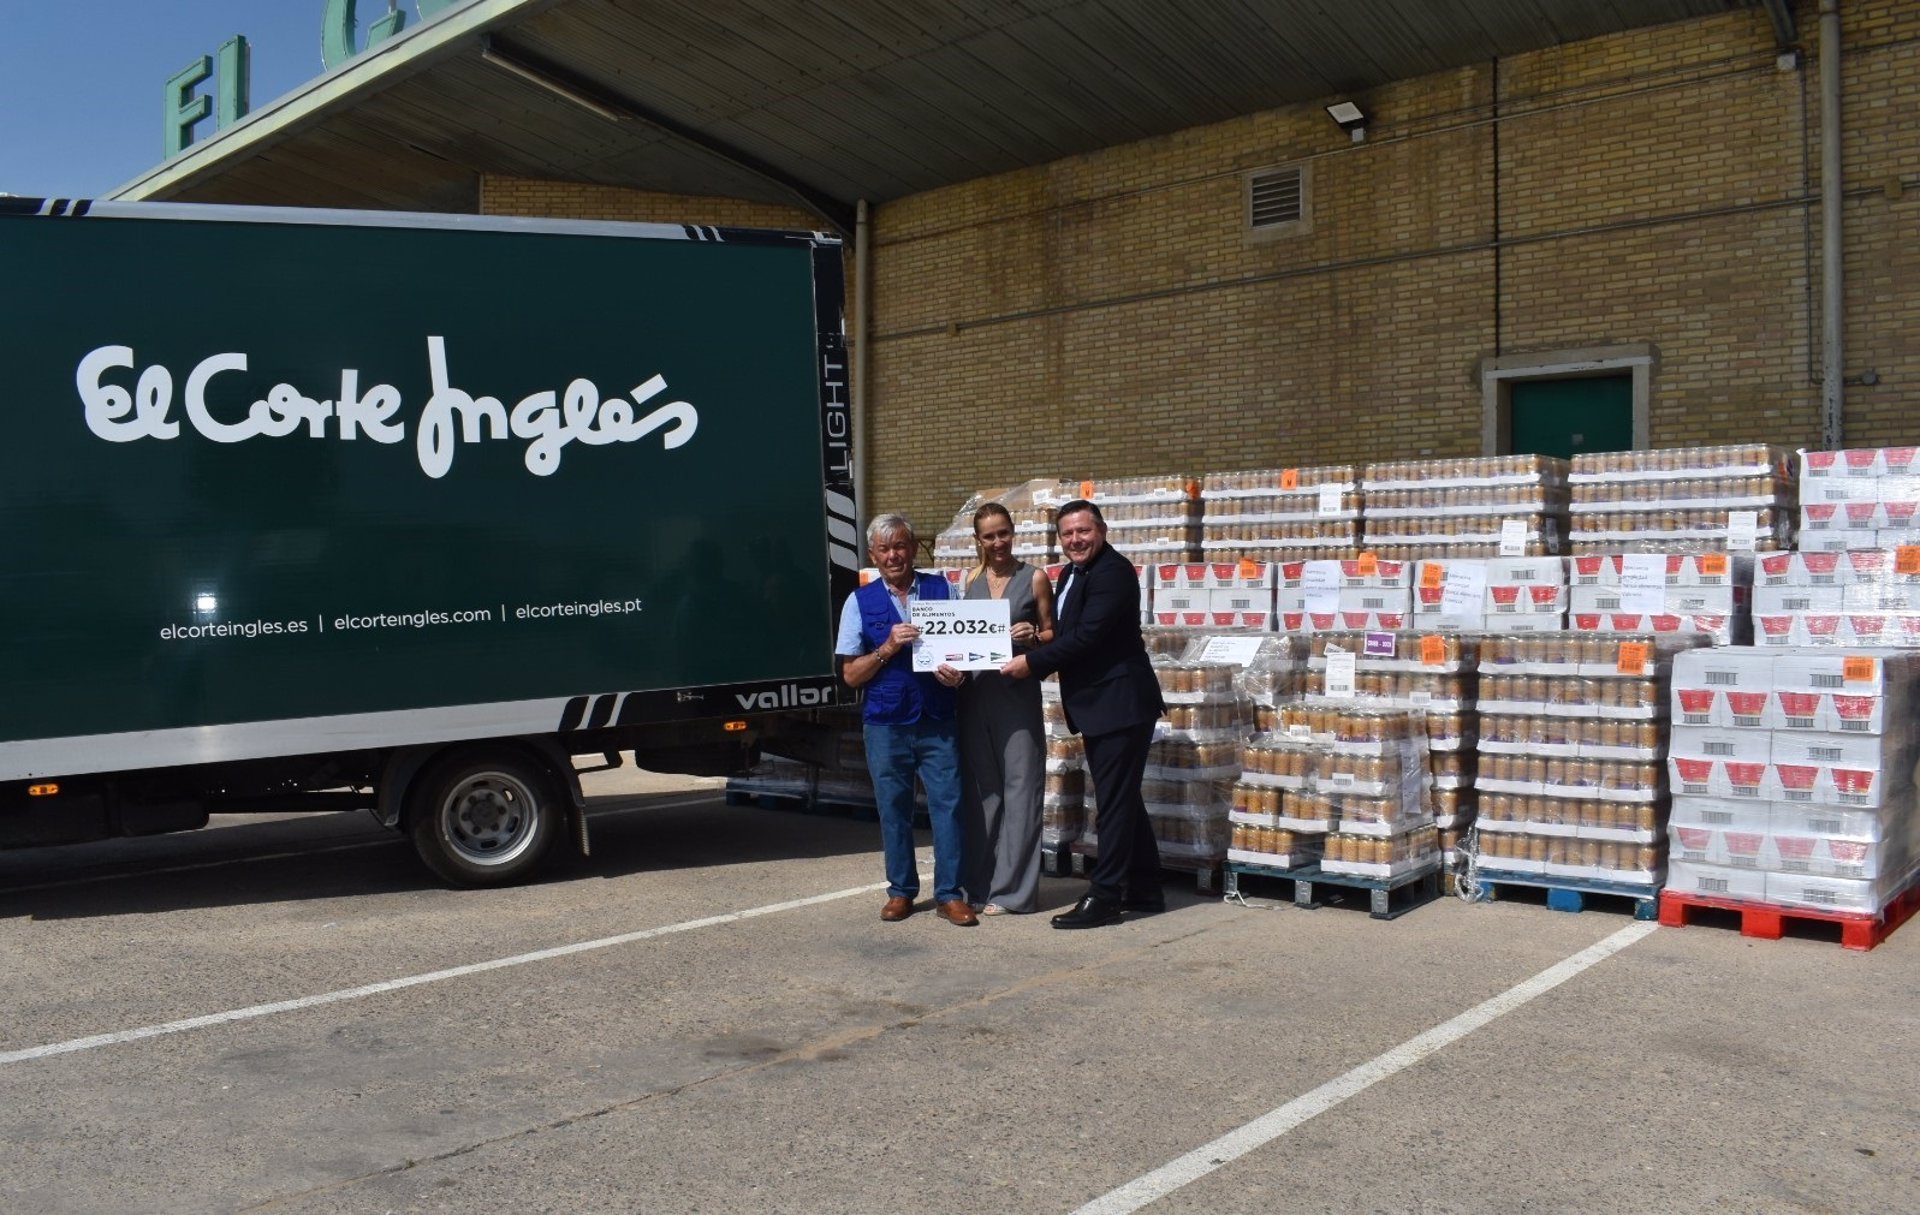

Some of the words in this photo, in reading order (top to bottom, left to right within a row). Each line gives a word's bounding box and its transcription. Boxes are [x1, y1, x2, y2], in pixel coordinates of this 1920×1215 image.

[77, 345, 180, 443] El
[185, 352, 405, 444] Corte
[416, 336, 698, 478] Inglés
[824, 354, 848, 471] LIGHT
[160, 616, 308, 640] elcorteingles.es
[334, 608, 492, 630] elcorteingles.com
[515, 597, 642, 619] elcorteingles.pt
[735, 683, 833, 711] vallor
